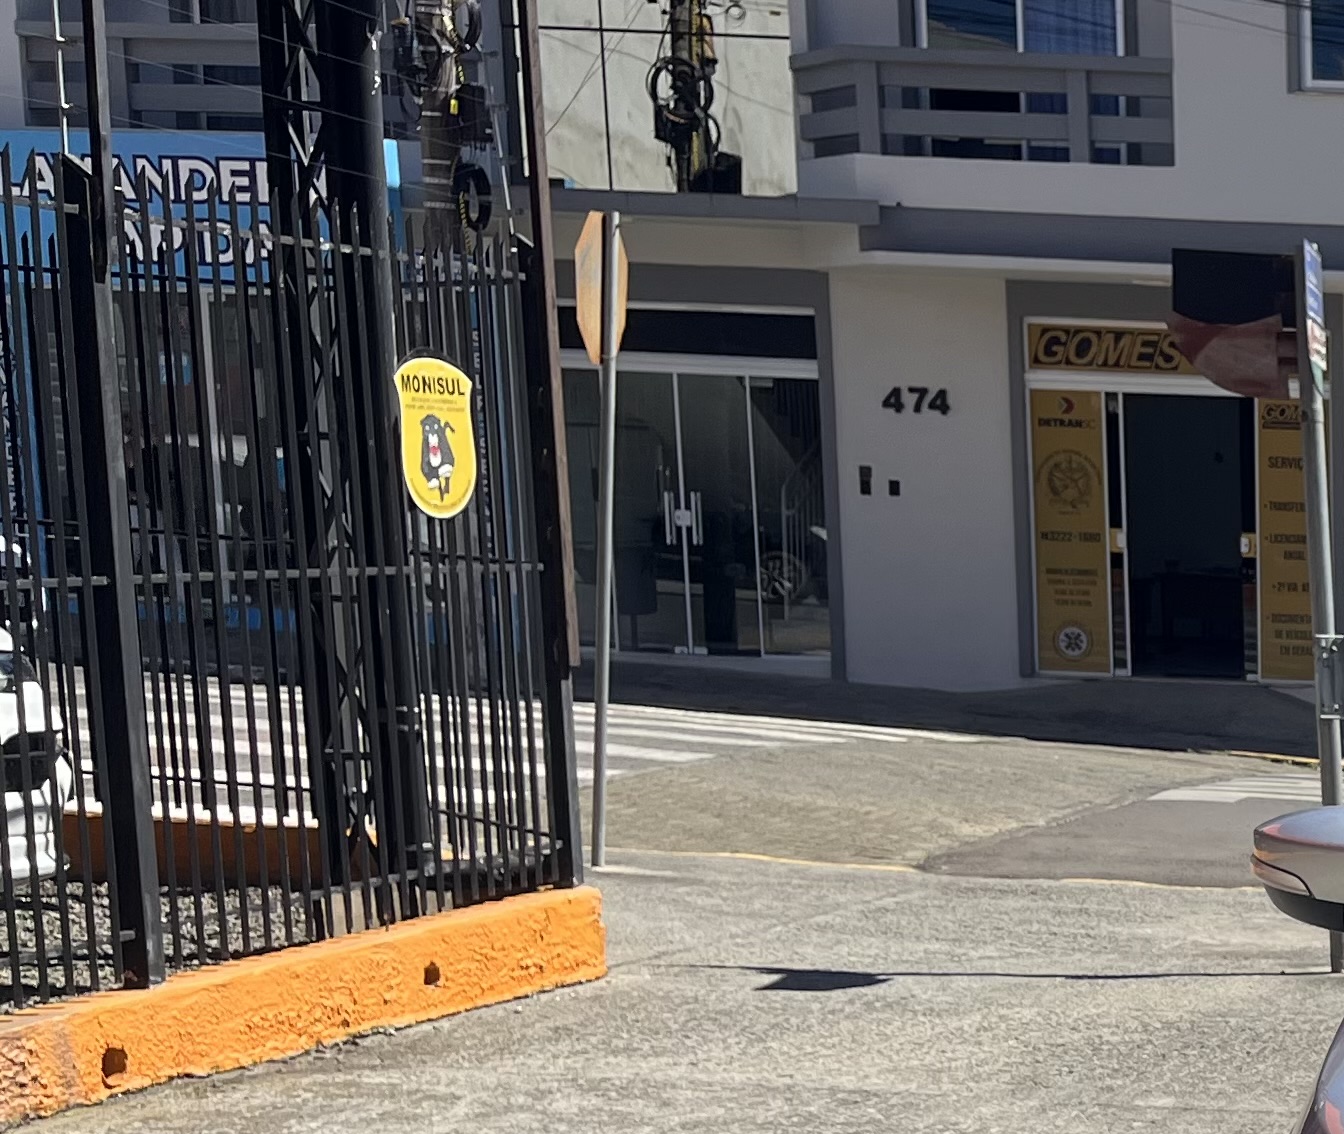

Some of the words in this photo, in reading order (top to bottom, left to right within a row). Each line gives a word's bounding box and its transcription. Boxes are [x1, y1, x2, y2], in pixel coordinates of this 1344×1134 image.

[1036, 330, 1182, 370] GOMES
[401, 373, 466, 396] MONISUL
[881, 386, 951, 417] 474
[1262, 404, 1303, 421] GOM
[1268, 456, 1304, 471] SERVIÇ
